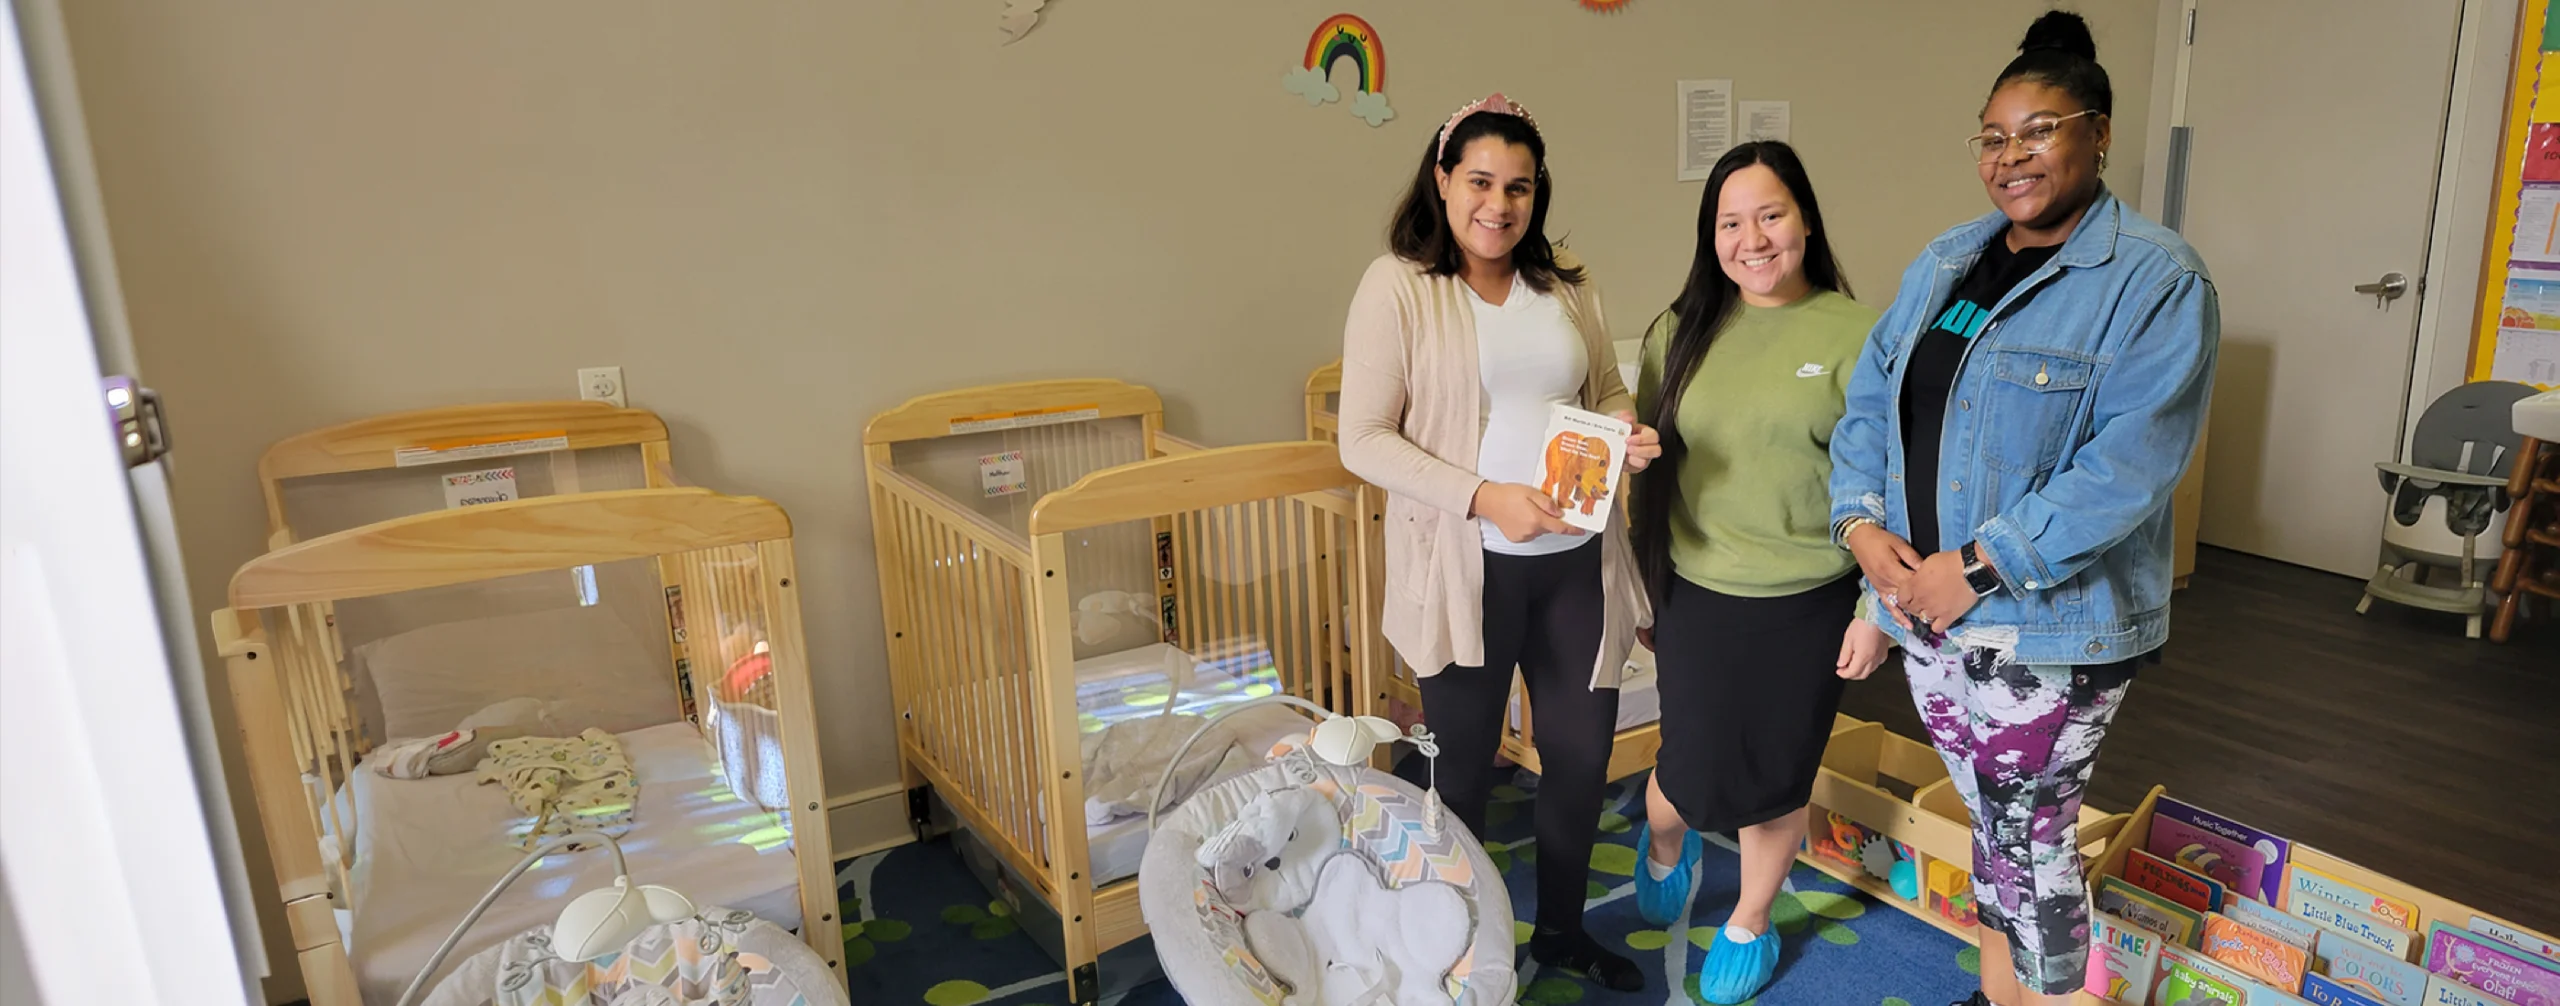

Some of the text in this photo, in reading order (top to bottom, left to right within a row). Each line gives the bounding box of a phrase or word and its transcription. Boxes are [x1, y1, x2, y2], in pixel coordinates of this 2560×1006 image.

[2192, 815, 2248, 841] Music Together
[2299, 877, 2360, 909] Winter
[2106, 926, 2151, 958] TIME!
[2303, 902, 2395, 953] Little Blue Truck
[2333, 956, 2404, 995] COLORS
[2488, 957, 2522, 975] FROZEN
[2174, 968, 2197, 989] Baby
[2197, 981, 2234, 1004] animals
[2311, 982, 2328, 1003] To
[2483, 979, 2517, 1000] Olaf!
